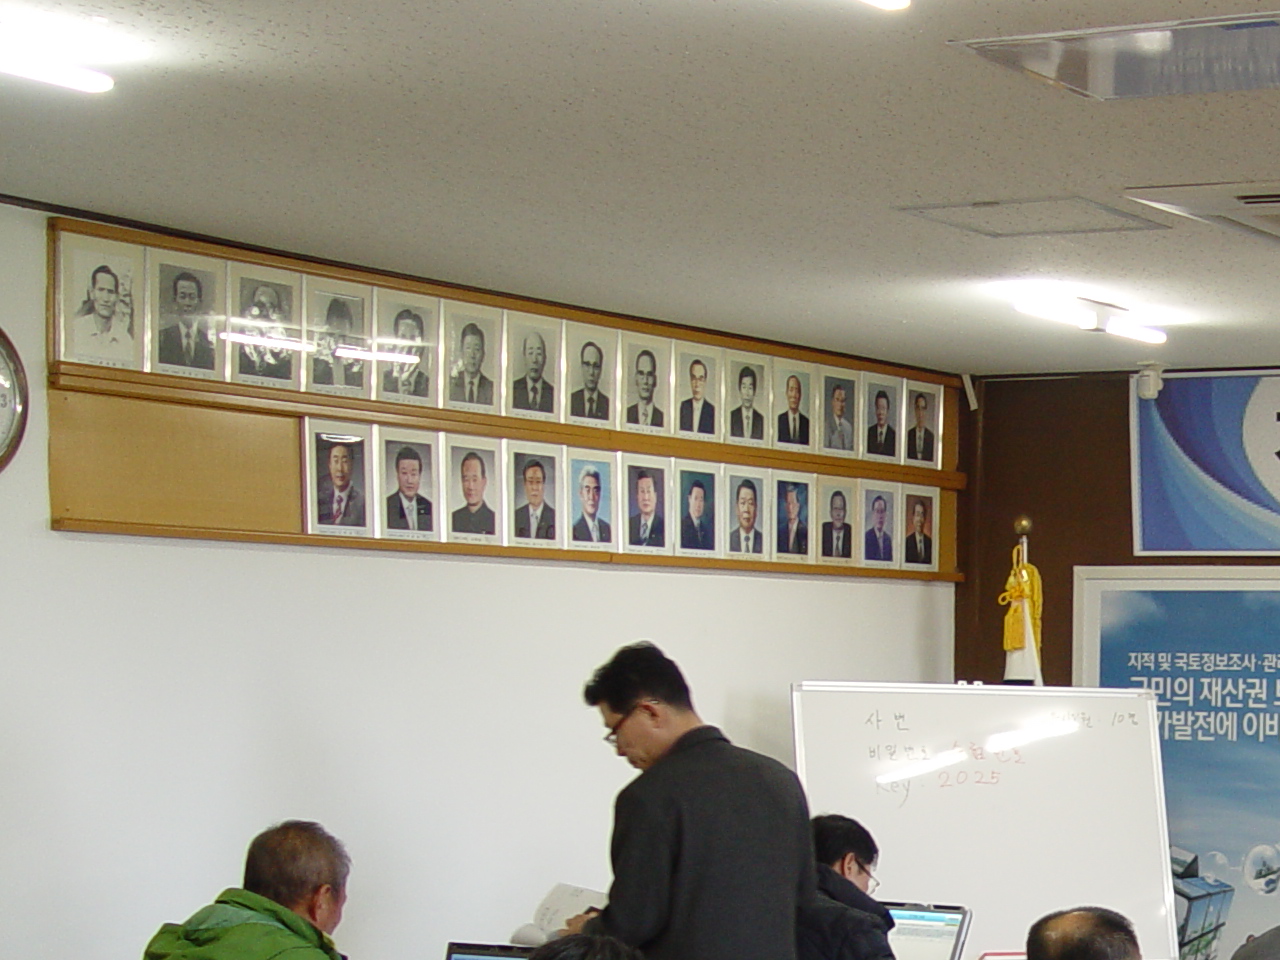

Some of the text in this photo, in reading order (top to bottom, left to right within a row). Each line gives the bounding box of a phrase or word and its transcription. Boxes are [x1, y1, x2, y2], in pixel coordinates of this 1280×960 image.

[1127, 652, 1156, 672] 지적
[1157, 652, 1172, 671] 및
[1199, 676, 1268, 709] 재산권
[1156, 710, 1238, 743] 가발전에
[938, 770, 1001, 788] 2025
